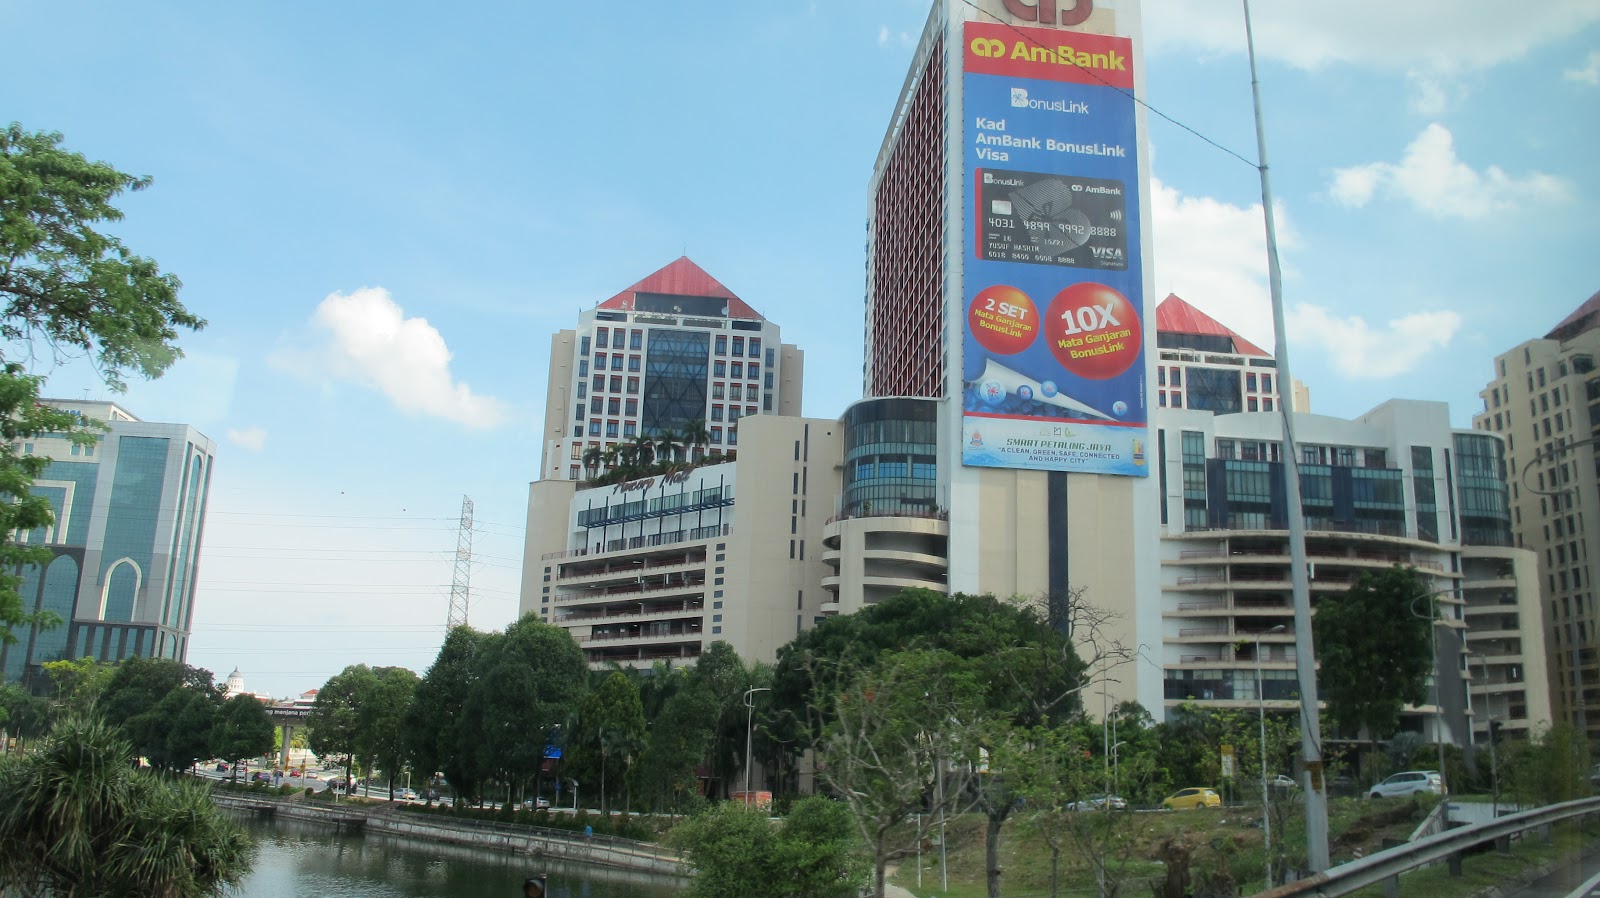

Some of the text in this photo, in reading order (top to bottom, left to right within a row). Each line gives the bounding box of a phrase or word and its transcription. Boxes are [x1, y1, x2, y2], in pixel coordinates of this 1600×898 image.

[1011, 41, 1125, 71] AmBank
[1010, 87, 1089, 115] BonusLink
[976, 117, 1006, 131] Kad
[975, 133, 1126, 157] AmBank BonusLink
[976, 147, 1009, 161] Visa
[983, 172, 1025, 187] BonusLink
[1085, 185, 1122, 195] AmBank
[988, 217, 1117, 237] 4031 4899 9992 8888
[988, 242, 1040, 252] YUSUF HASHIM
[1089, 245, 1123, 260] VISA
[984, 298, 1028, 320] 2 SET
[1060, 302, 1121, 335] 10X
[974, 308, 1032, 332] Mata Ganjaran
[979, 319, 1023, 339] BonusLink
[1058, 328, 1131, 349] Mata Ganjaran
[1070, 341, 1126, 360] BonusLink
[1006, 438, 1112, 452] SMART PETALING JAYA
[1080, 452, 1120, 460] CONNECTED
[659, 463, 696, 489] Mall
